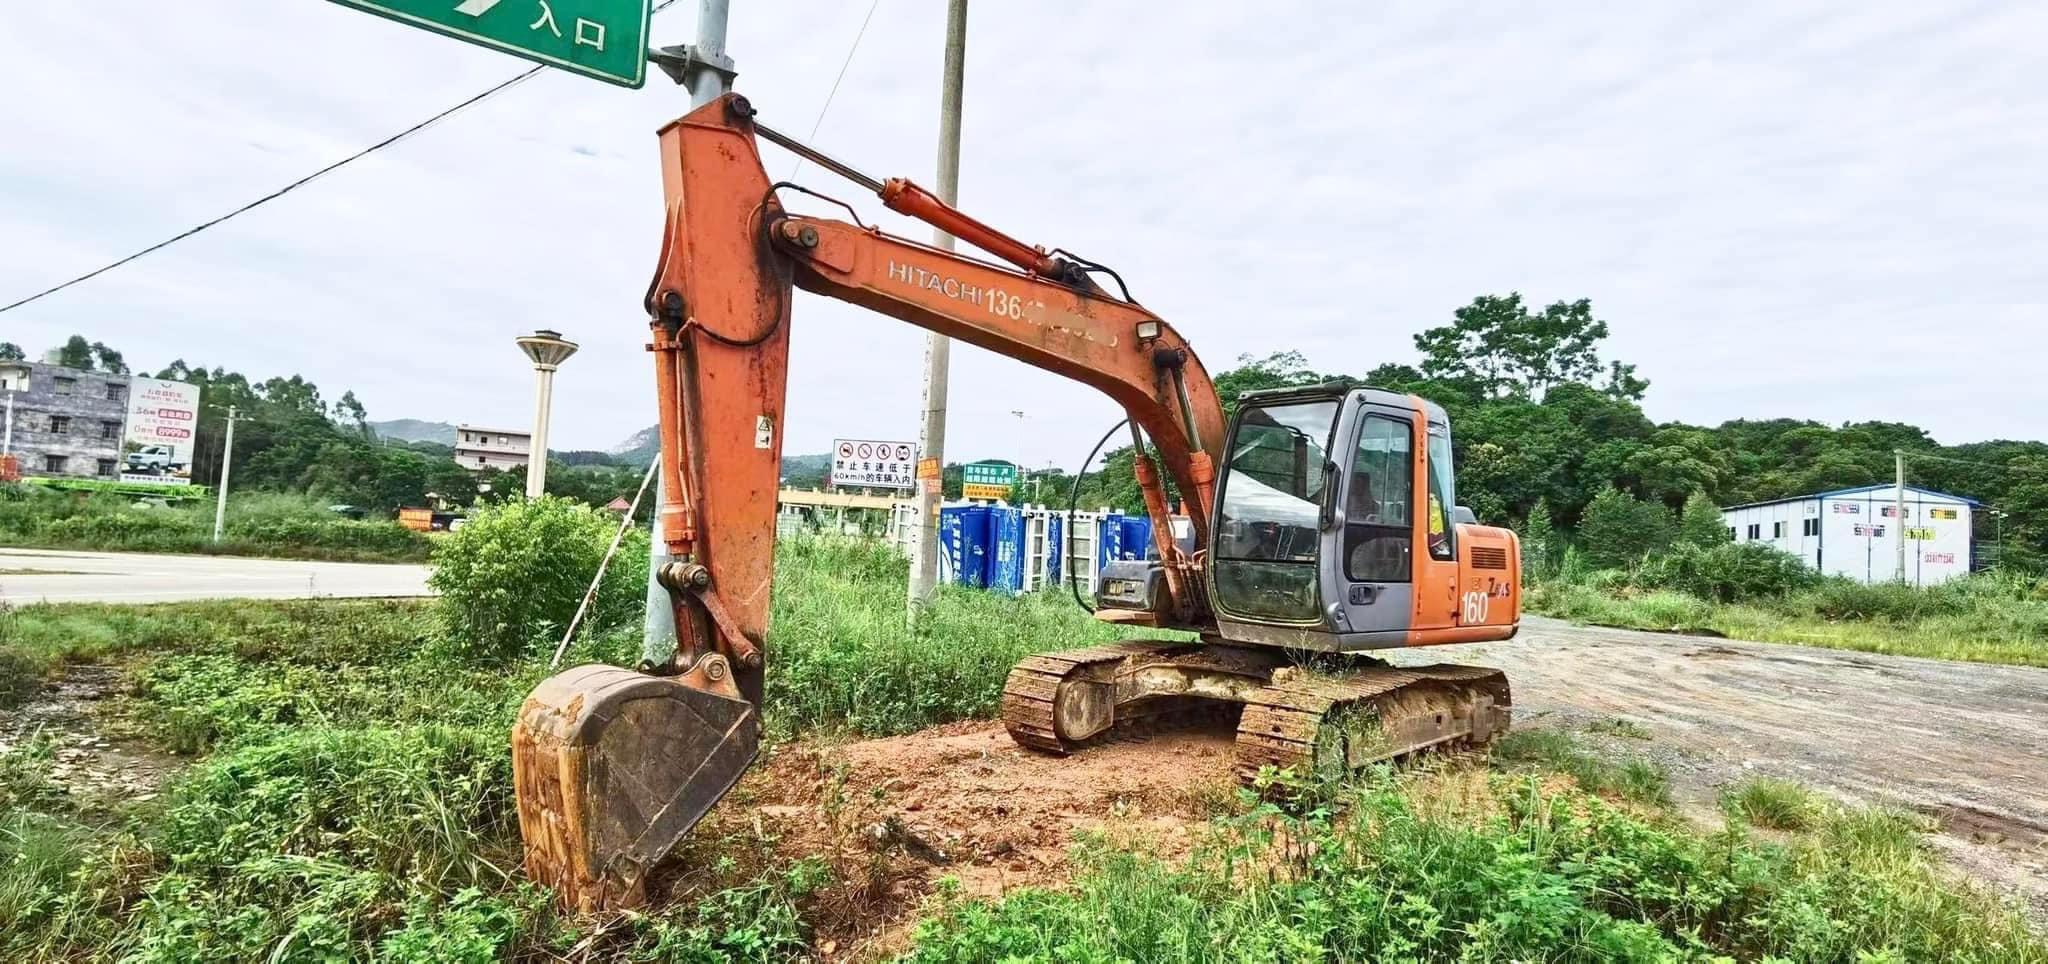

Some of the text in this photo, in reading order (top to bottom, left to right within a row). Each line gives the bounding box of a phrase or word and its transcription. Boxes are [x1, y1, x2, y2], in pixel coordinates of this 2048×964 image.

[529, 0, 606, 52] 入口
[887, 258, 982, 305] HITACHI
[834, 473, 911, 485] 60km/h的车辆入内
[836, 460, 912, 474] 禁止车速低于
[1461, 591, 1489, 624] 160
